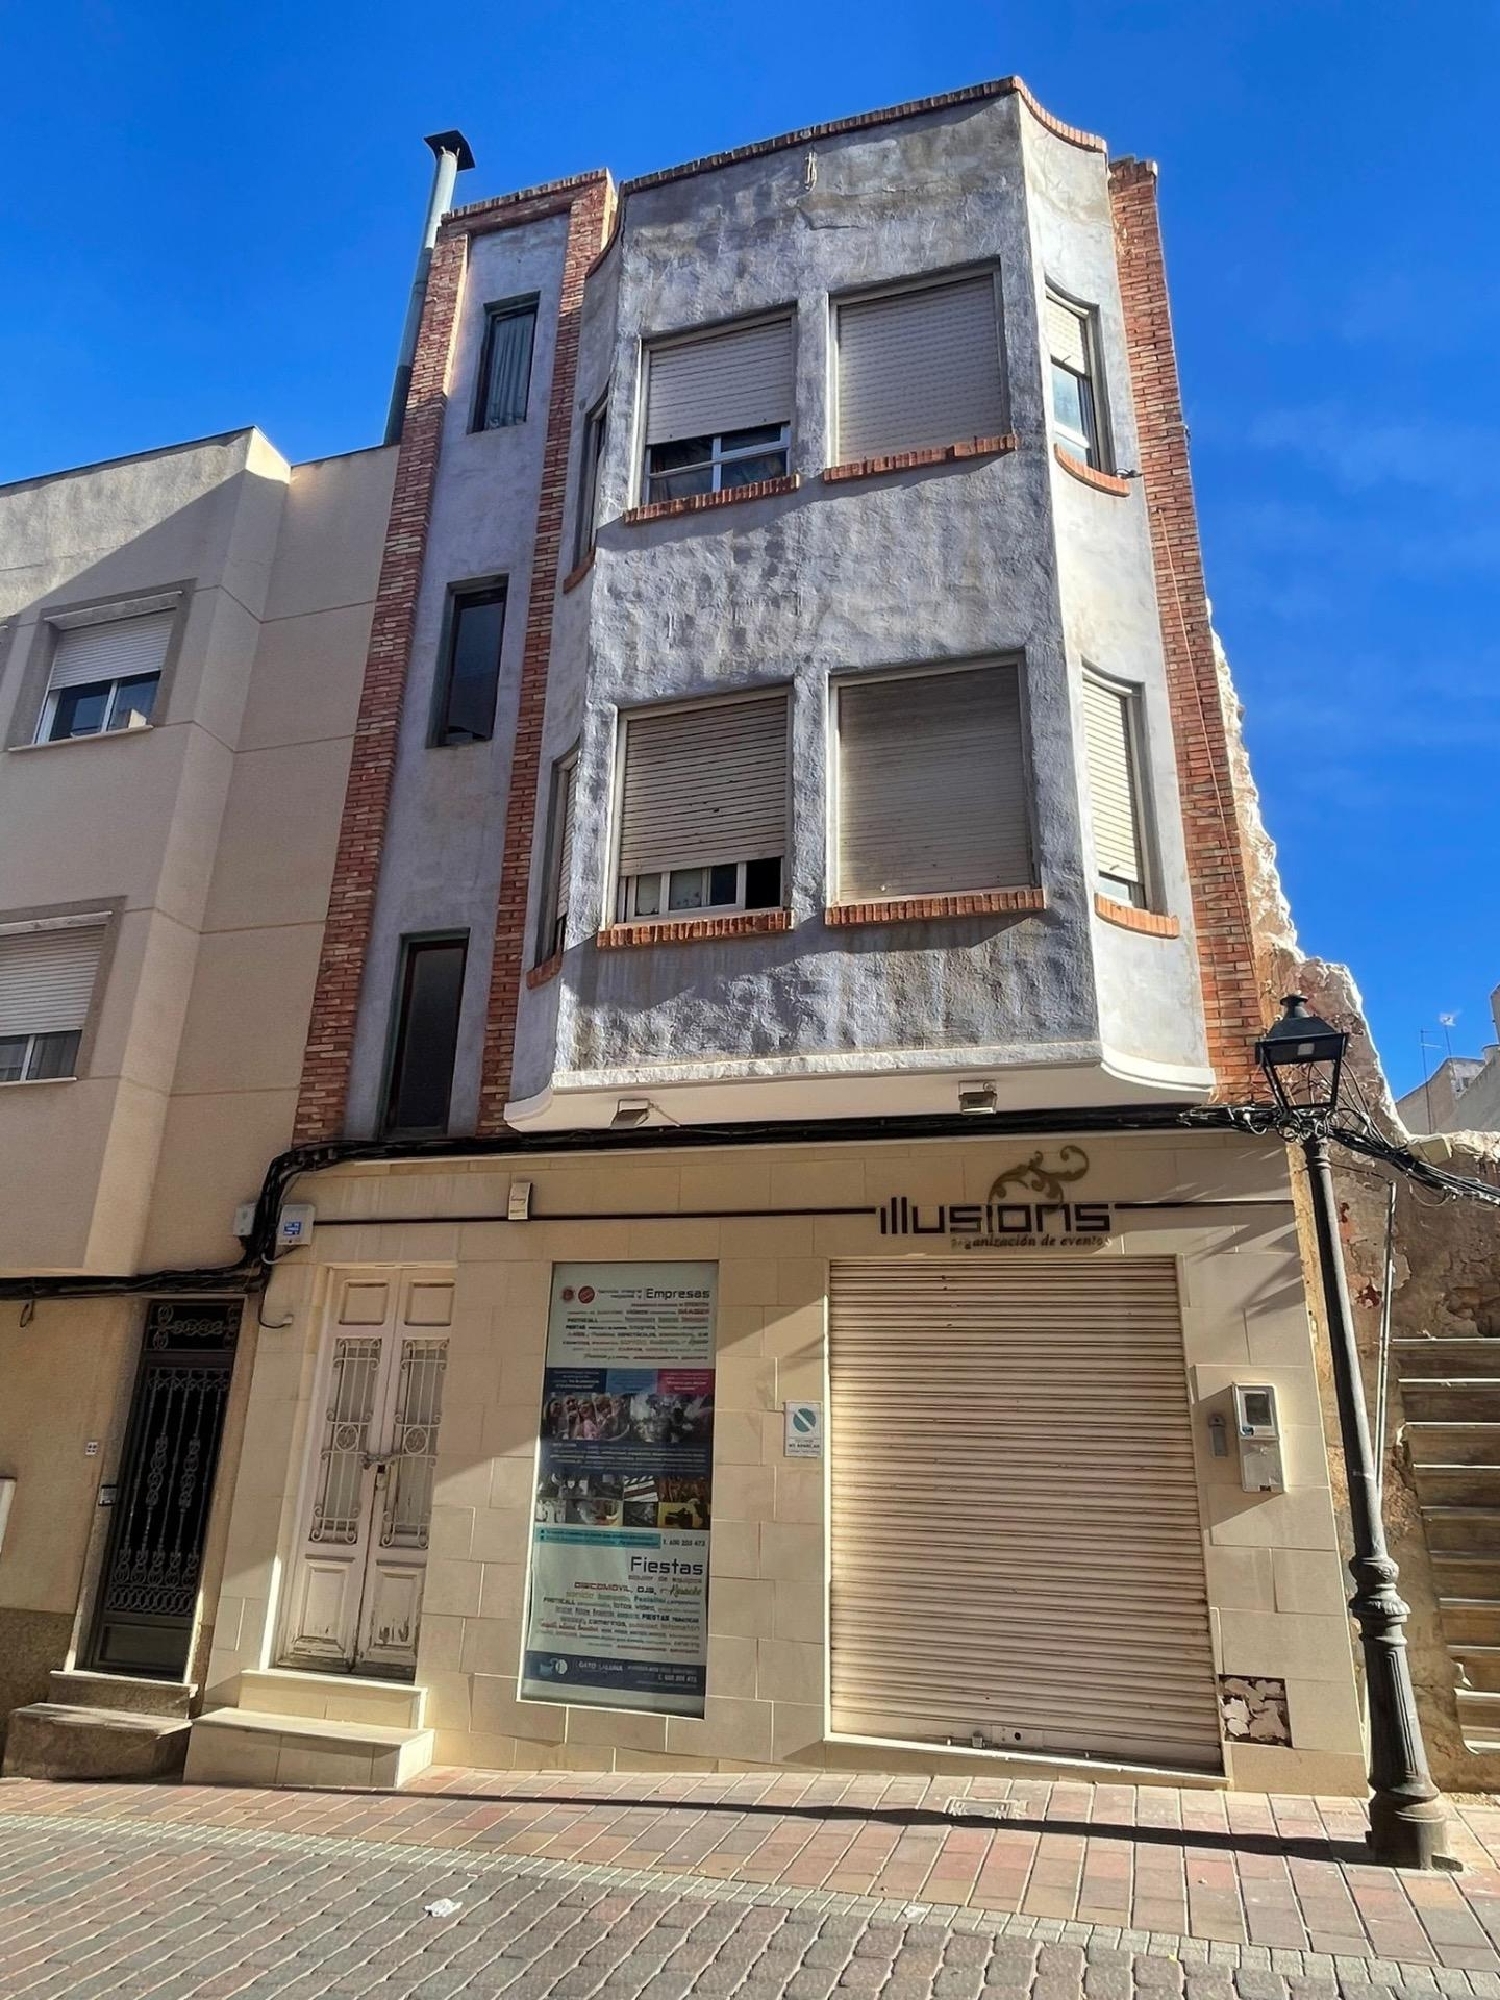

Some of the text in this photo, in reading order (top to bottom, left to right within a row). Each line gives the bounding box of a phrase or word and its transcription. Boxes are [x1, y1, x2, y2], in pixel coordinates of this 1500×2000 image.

[1041, 1234, 1056, 1247] de
[645, 1288, 711, 1301] Empresas
[630, 1556, 704, 1576] Fiestas
